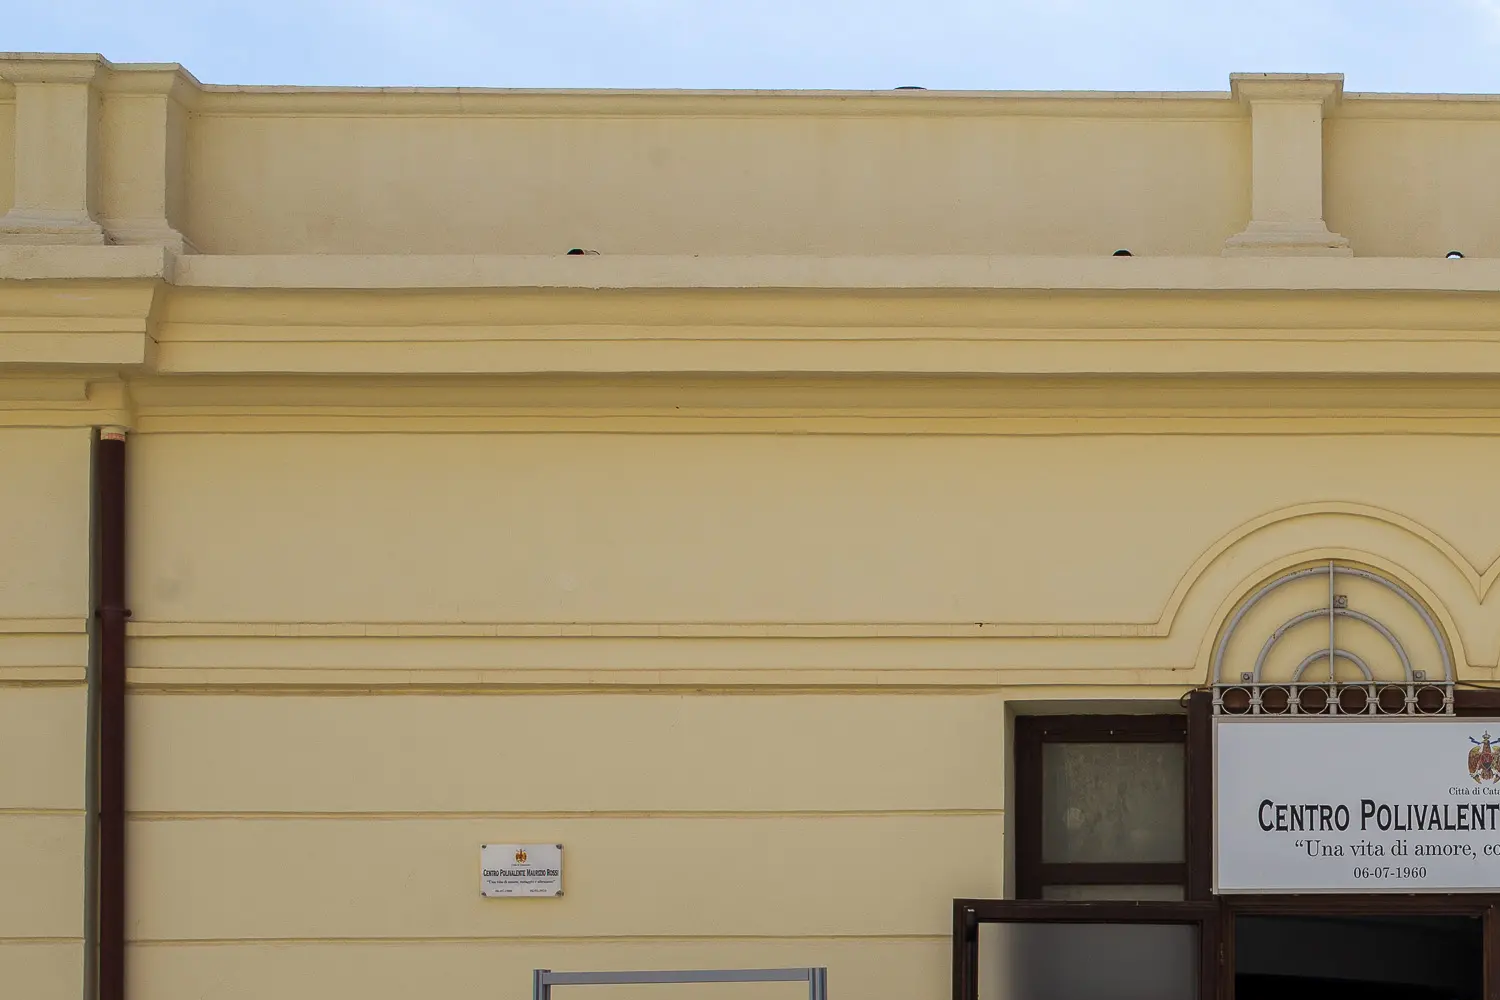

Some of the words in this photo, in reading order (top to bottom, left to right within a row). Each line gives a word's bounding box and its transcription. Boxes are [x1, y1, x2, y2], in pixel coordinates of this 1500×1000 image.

[1448, 786, 1470, 796] Città
[1472, 786, 1480, 796] di
[1258, 799, 1350, 832] CENTRO
[1350, 839, 1385, 857] vita
[1391, 839, 1408, 857] di
[1414, 844, 1477, 860] amore,
[1353, 866, 1427, 879] 06-07-1960
